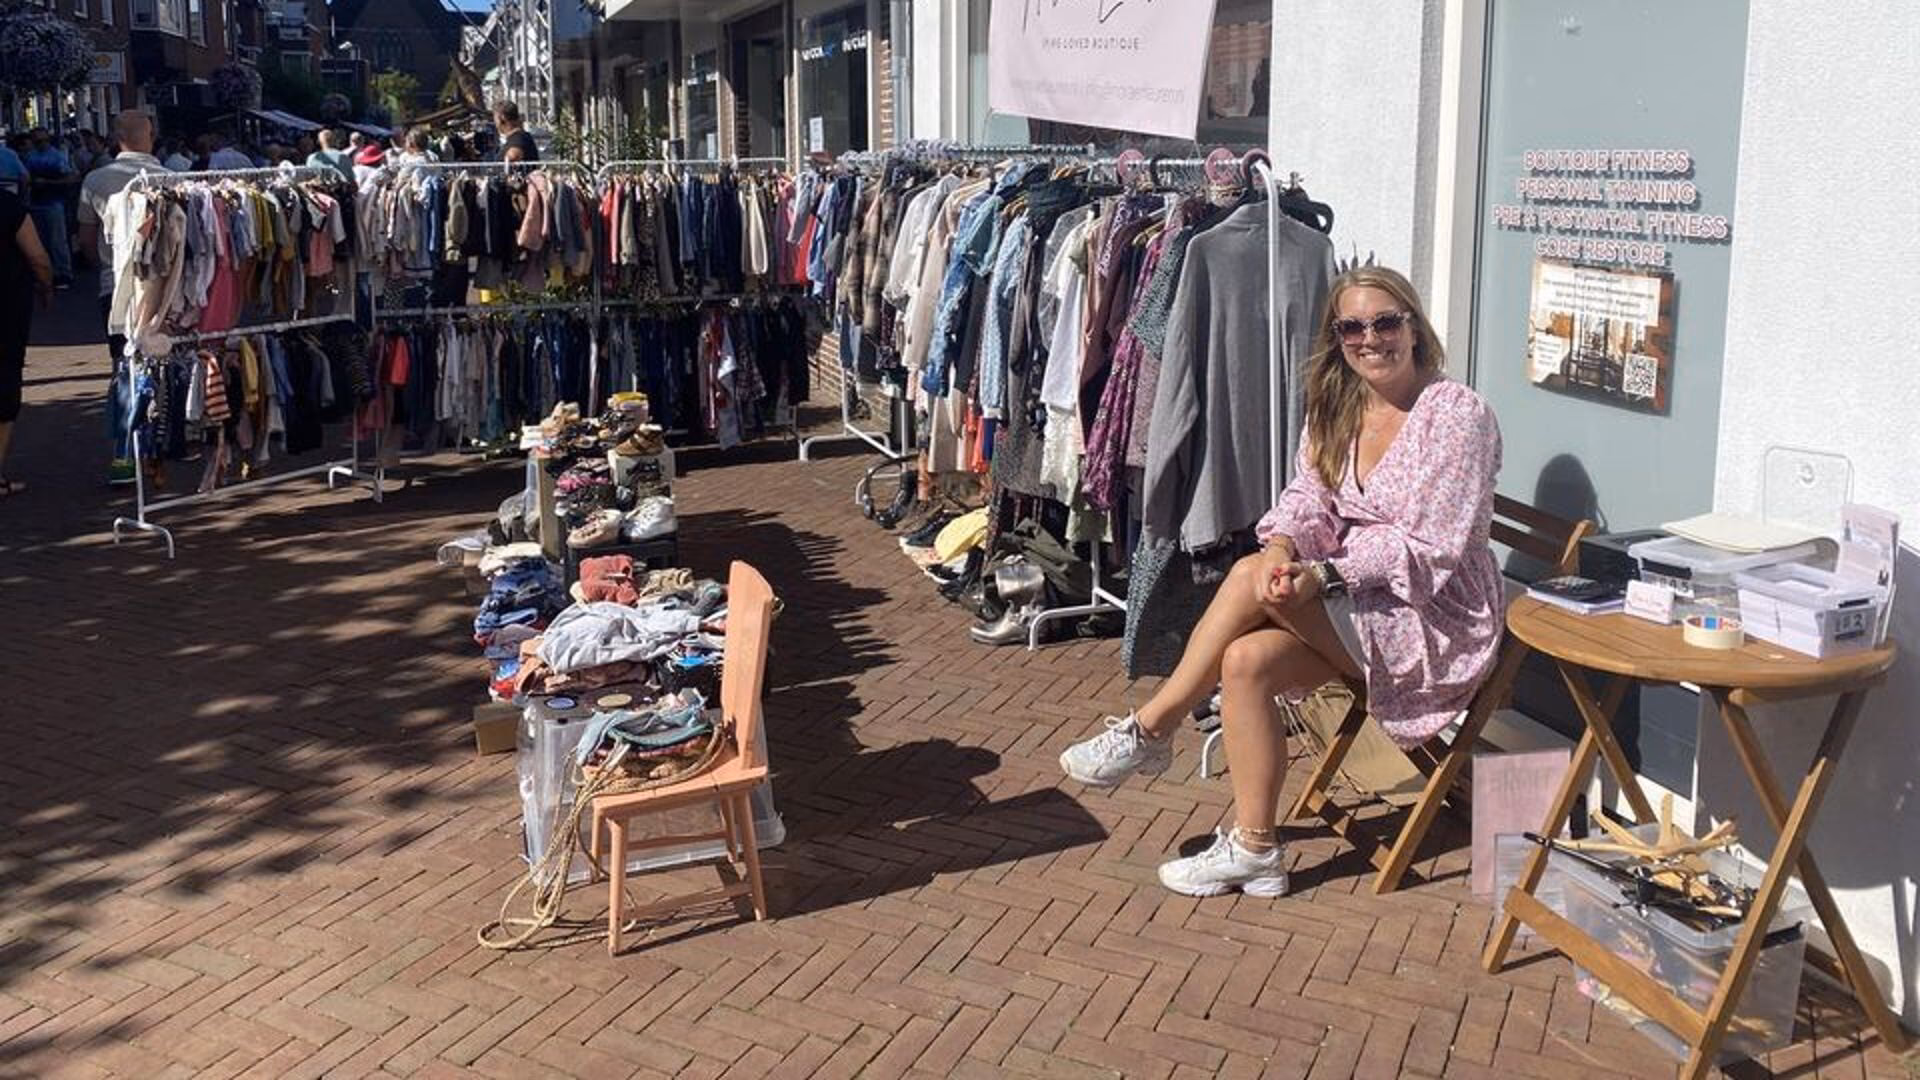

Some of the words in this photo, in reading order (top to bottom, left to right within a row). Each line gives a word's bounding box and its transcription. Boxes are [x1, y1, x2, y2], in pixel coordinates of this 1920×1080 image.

[1093, 37, 1139, 50] BOUTIQUE
[1524, 150, 1609, 171] BOUTIQUE
[1612, 150, 1690, 173] FITNESS
[1517, 178, 1602, 200] PERSONAL
[1607, 180, 1696, 204] TRAINING
[1493, 205, 1520, 226] PRE
[1540, 207, 1640, 233] POSTNATAL
[1646, 212, 1728, 238] FITNESS
[1536, 236, 1580, 258] CORE
[1584, 239, 1666, 264] RESTORE
